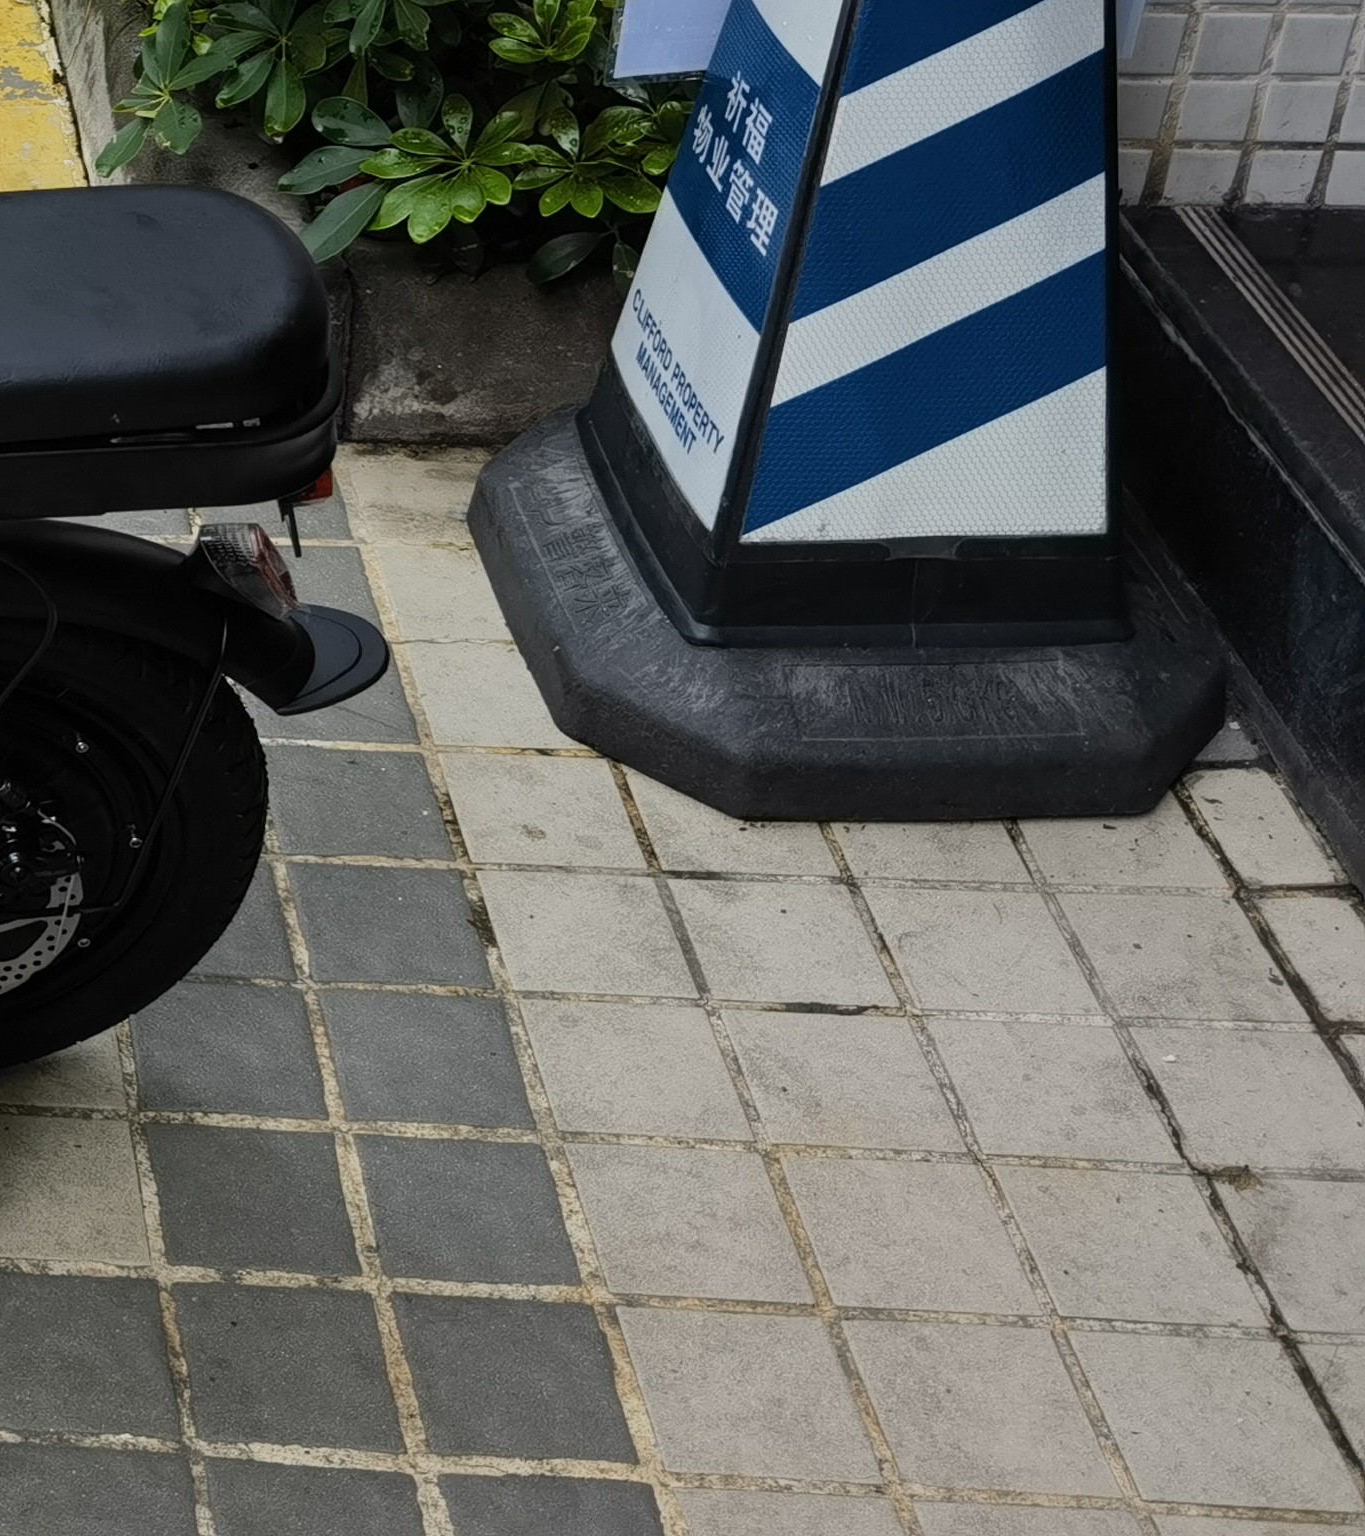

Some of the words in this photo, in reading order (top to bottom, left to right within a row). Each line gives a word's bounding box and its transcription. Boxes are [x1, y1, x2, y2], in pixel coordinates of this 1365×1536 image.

[692, 103, 779, 257] 物业管理
[724, 69, 773, 165] 祈福
[632, 288, 673, 372] CLIFFORD
[670, 361, 725, 454] PROPERTY
[635, 340, 697, 455] MANAGEMENT
